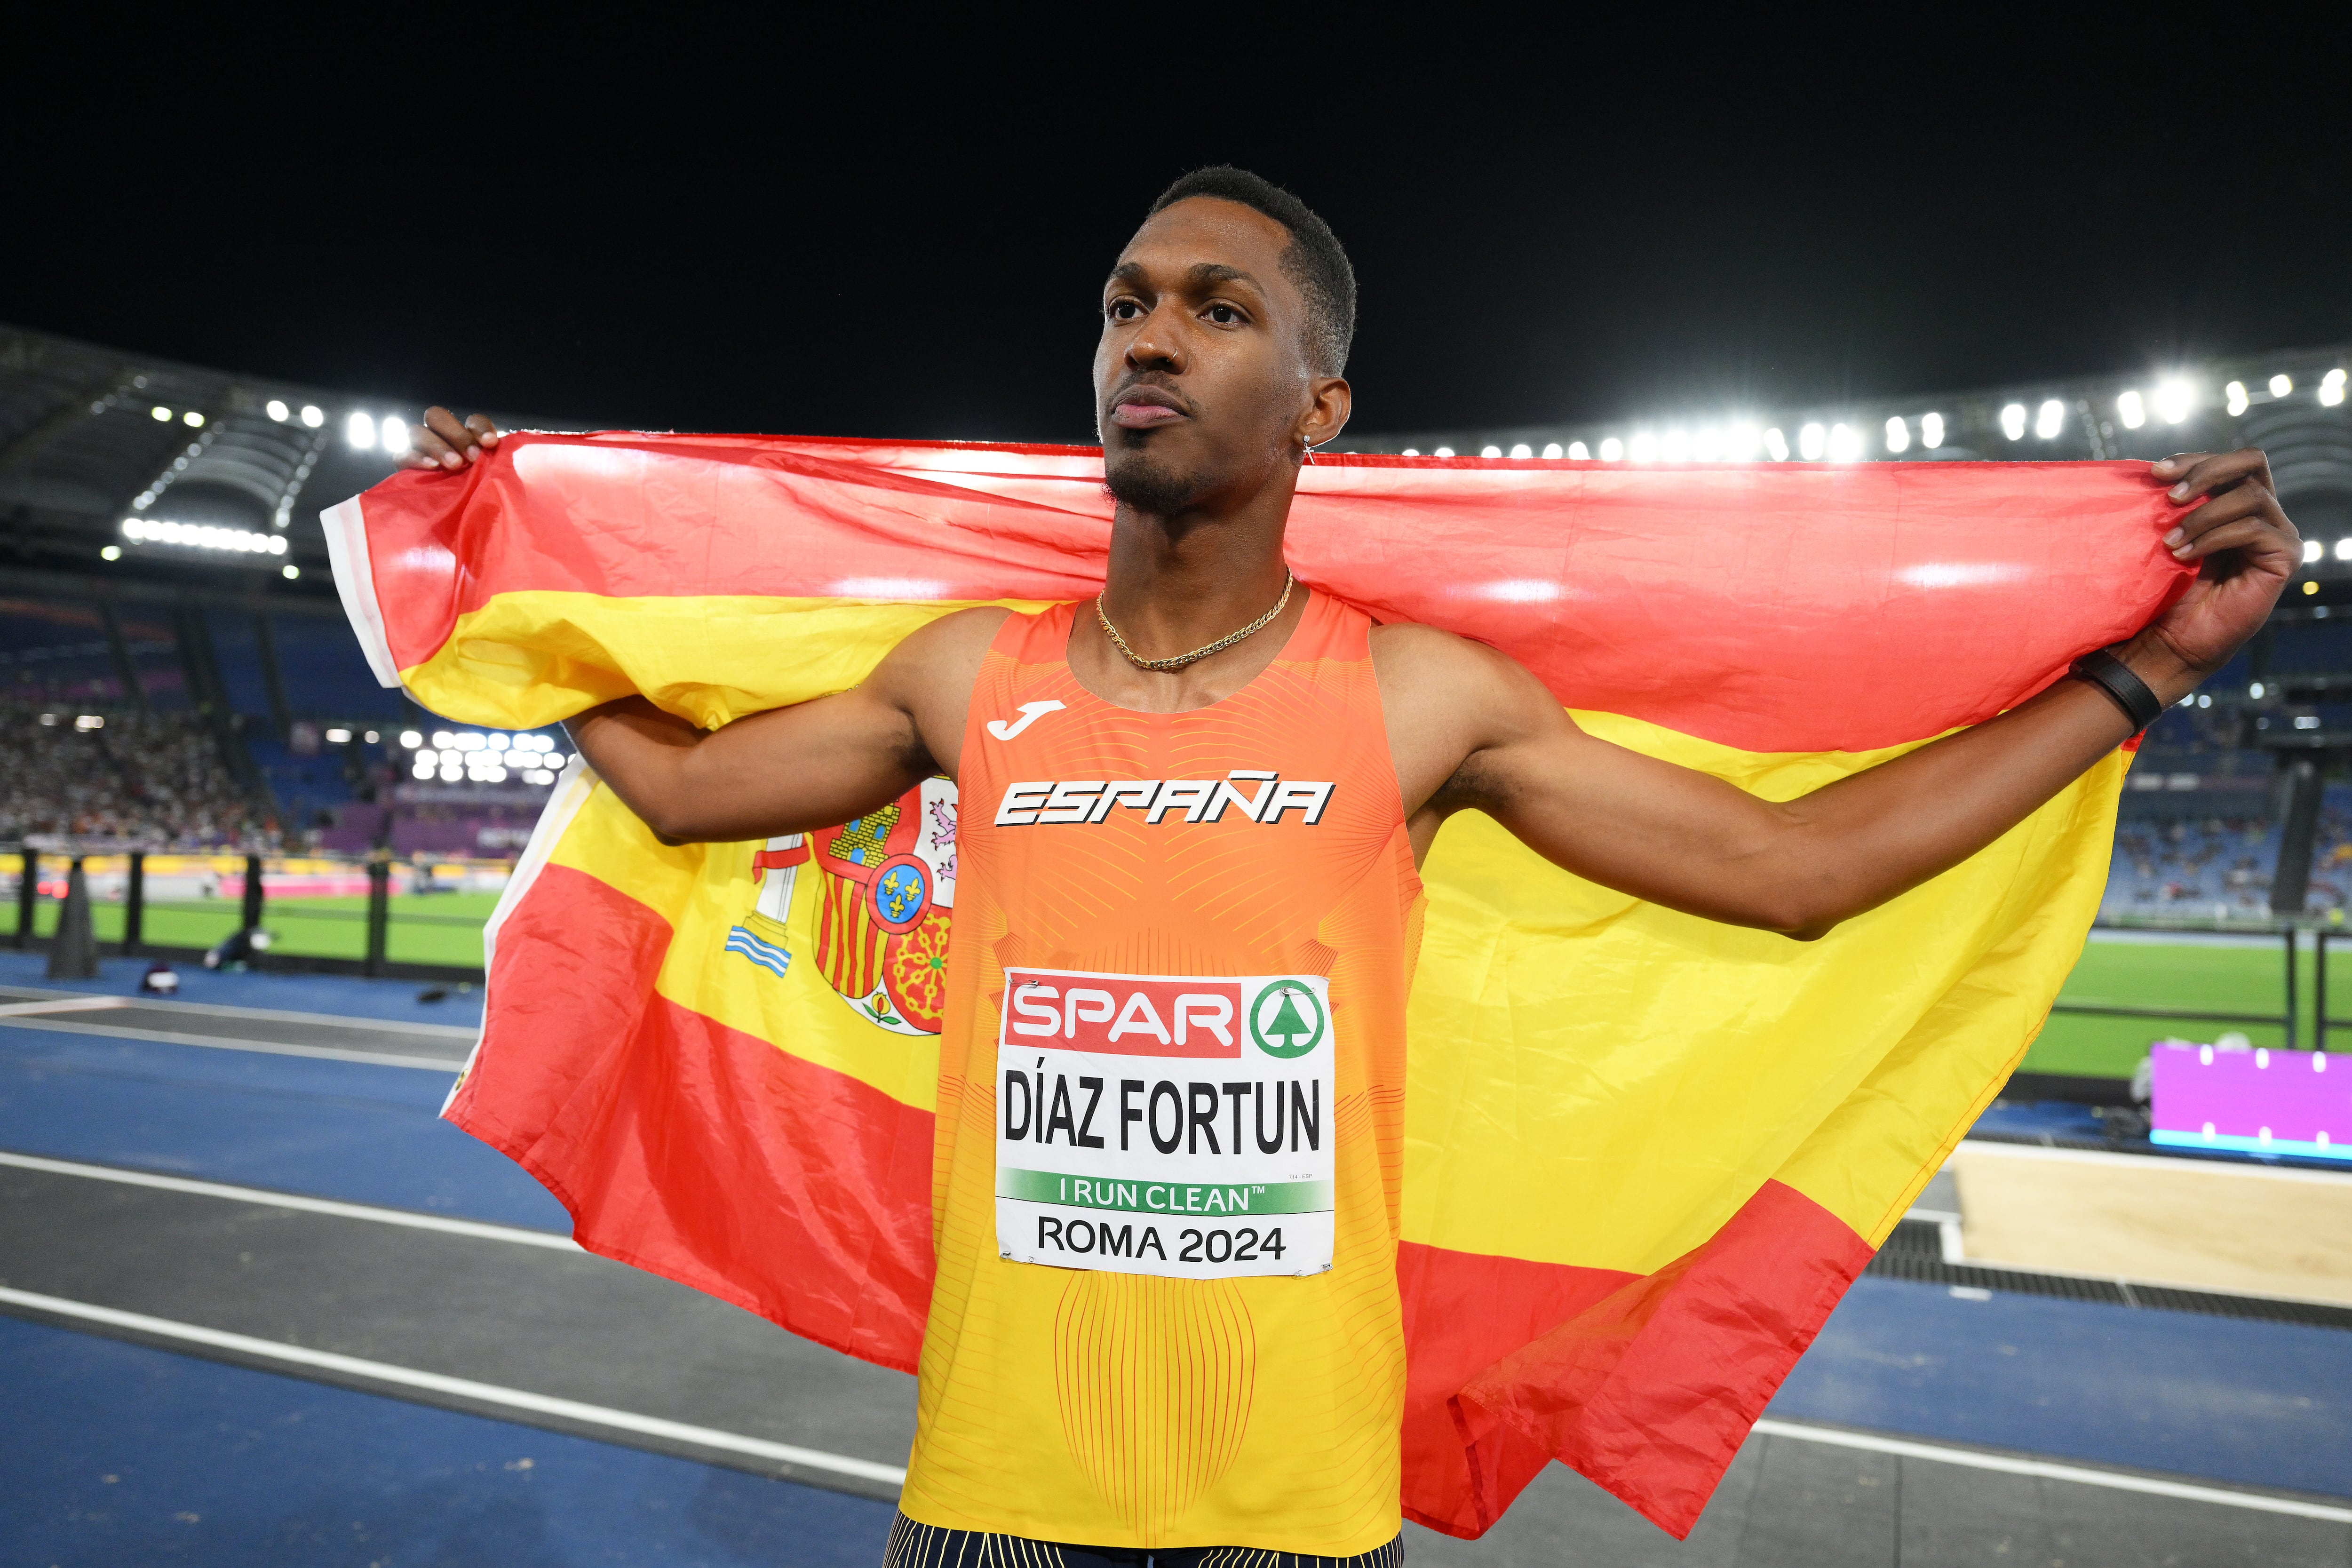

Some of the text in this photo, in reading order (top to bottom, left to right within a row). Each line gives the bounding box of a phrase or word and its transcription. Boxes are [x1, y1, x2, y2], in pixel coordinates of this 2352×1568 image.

[993, 770, 1336, 828] ESPAÑA
[1013, 984, 1234, 1047] SPAR
[1005, 1057, 1319, 1154] DÍAZ FORTUN
[1060, 1178, 1066, 1201] I
[1074, 1179, 1137, 1207] RUN
[1038, 1216, 1287, 1263] ROMA 2024
